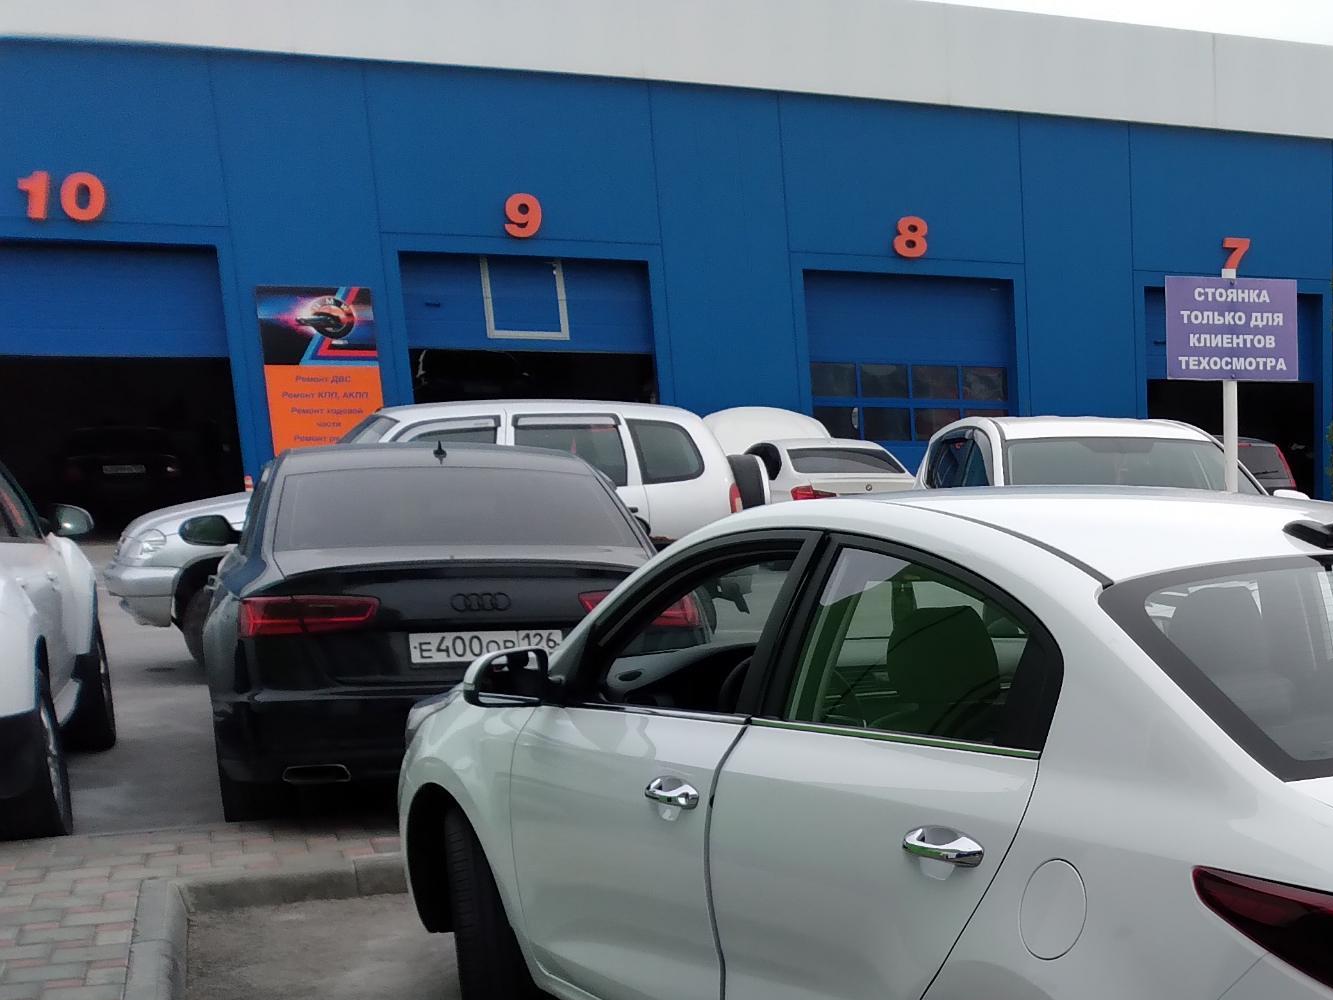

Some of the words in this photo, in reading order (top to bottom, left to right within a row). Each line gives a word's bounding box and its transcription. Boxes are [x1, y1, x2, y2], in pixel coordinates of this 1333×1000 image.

[17, 170, 107, 221] 10
[504, 193, 542, 238] 9
[893, 215, 928, 258] 8
[1222, 237, 1251, 270] 7
[1194, 287, 1270, 303] СТОЯНКА
[1180, 310, 1246, 325] ТОЛЬКО
[1250, 312, 1284, 327] ДЛЯ
[1189, 333, 1276, 348] КЛИЕНТОВ
[1178, 356, 1287, 371] ТЕХОСМОТРА
[282, 391, 315, 399] Ремонт
[342, 391, 368, 399] АКПП
